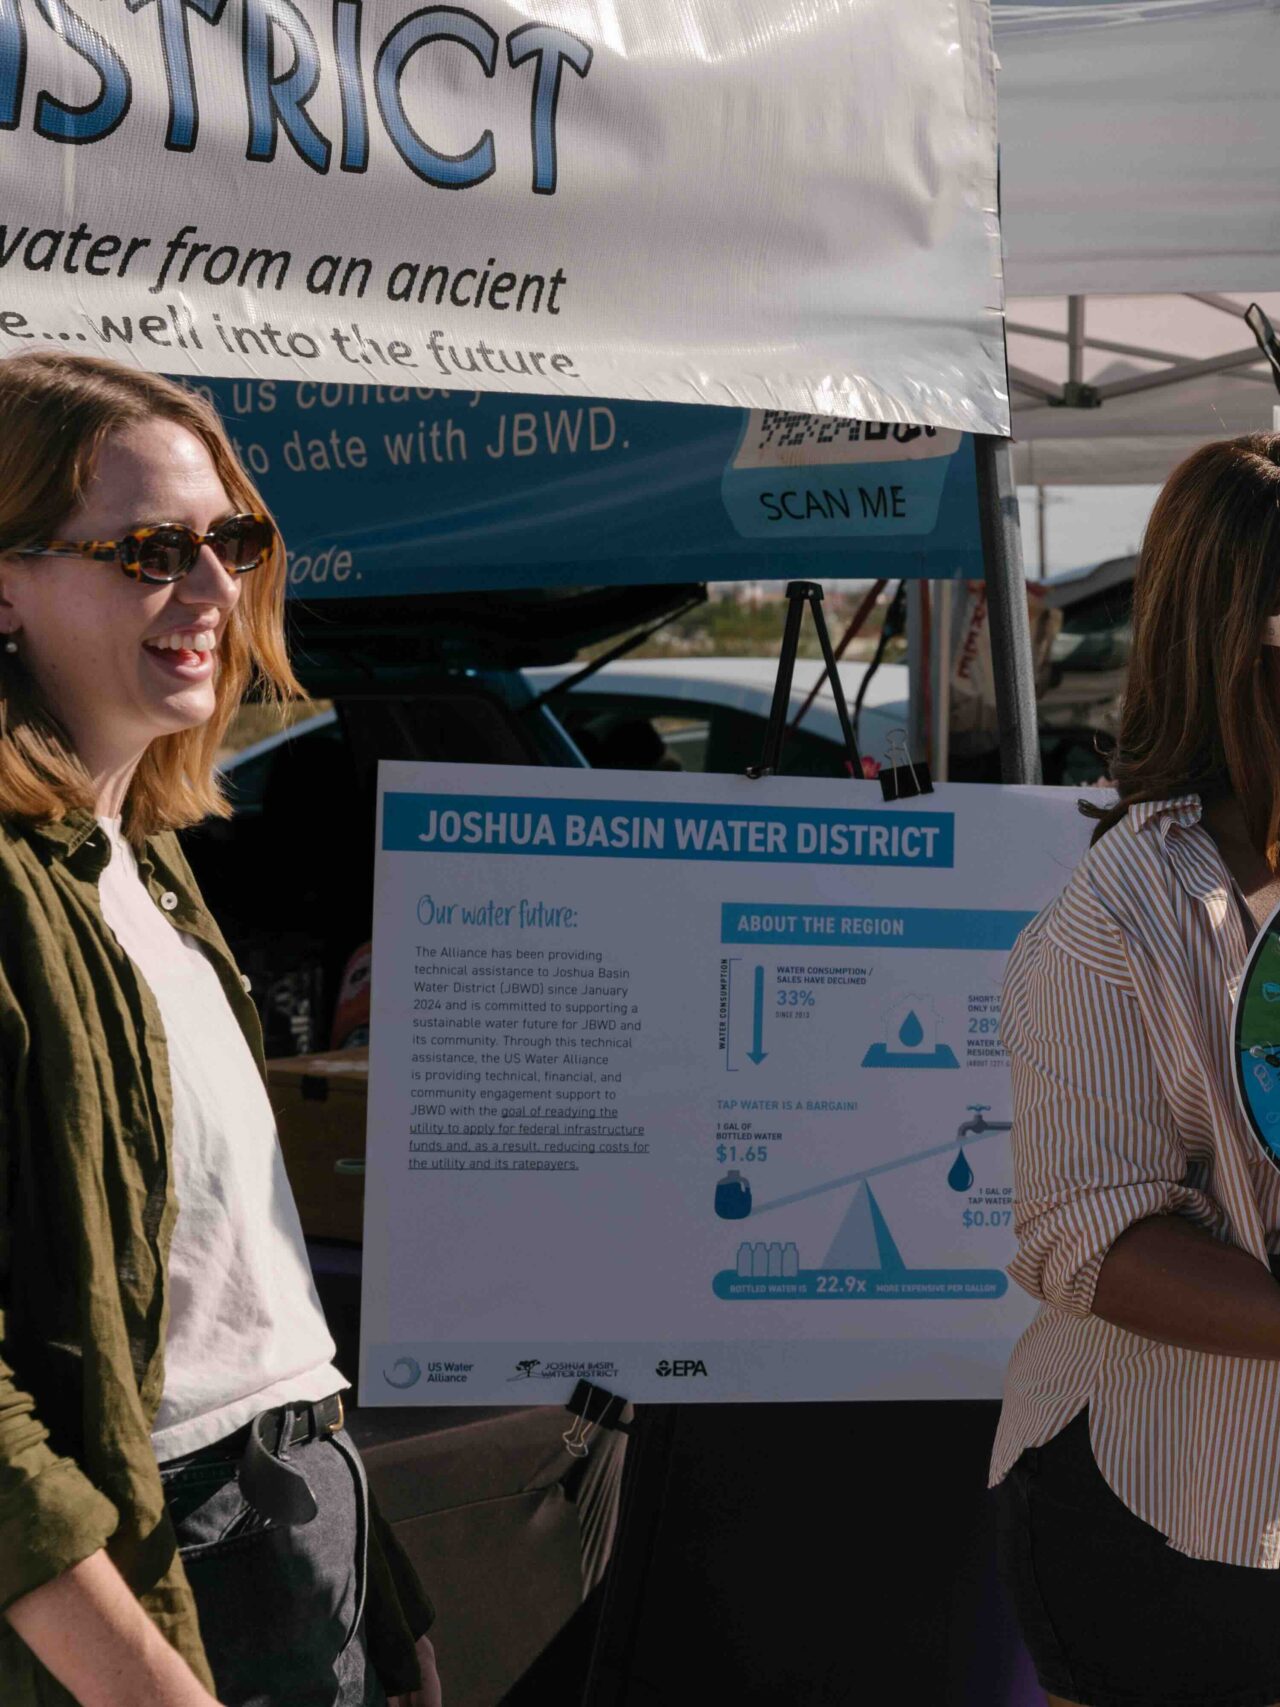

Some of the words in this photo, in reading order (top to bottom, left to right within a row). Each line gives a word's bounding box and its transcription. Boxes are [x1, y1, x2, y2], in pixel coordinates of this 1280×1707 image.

[150, 225, 291, 294] from
[306, 252, 373, 298] an
[386, 257, 567, 315] ancient
[212, 313, 321, 358] into
[330, 323, 418, 368] the
[426, 330, 580, 378] future
[233, 381, 276, 413] us
[284, 430, 368, 472] date
[384, 419, 467, 465] with
[486, 406, 629, 458] JBWD.
[760, 488, 850, 520] SCAN
[858, 486, 906, 518] ME
[418, 810, 557, 847] JOSHUA
[566, 814, 665, 850] BASIN
[674, 818, 787, 853] WATER
[797, 822, 940, 858] DISTRICT
[417, 894, 458, 925] Our
[461, 899, 515, 928] water
[518, 899, 578, 929] future:
[737, 915, 797, 932] ABOUT
[803, 916, 835, 934] THE
[841, 917, 904, 936] REGION
[416, 947, 436, 958] The
[440, 947, 487, 958] Alliance
[491, 948, 512, 959] has
[516, 949, 544, 960] been
[548, 950, 603, 962] providing
[415, 964, 468, 976] technical
[472, 966, 534, 977] assistance
[538, 967, 549, 978] to
[553, 967, 594, 978] Joshua
[598, 968, 630, 979] Basin
[808, 967, 866, 976] CONSUMPTION
[777, 976, 802, 984] SALES
[804, 976, 825, 984] HAVE
[827, 976, 866, 985] DECLINED
[414, 982, 449, 993] Water
[454, 982, 496, 994] District
[500, 982, 544, 996] (JBWD)
[548, 984, 577, 996] since
[582, 985, 628, 998] January
[720, 959, 728, 1018] CONSUMPTION
[777, 990, 815, 1006] 33%
[414, 1000, 441, 1010] 2024
[445, 1000, 466, 1010] and
[471, 1000, 481, 1010] is
[485, 1000, 546, 1012] committed
[550, 1002, 561, 1012] to
[565, 1003, 627, 1016] supporting
[631, 1004, 639, 1014] a
[413, 1017, 481, 1028] sustainable
[485, 1018, 519, 1029] water
[523, 1018, 558, 1030] future
[562, 1019, 578, 1030] for
[582, 1020, 617, 1030] JBWD
[620, 1020, 641, 1031] and
[412, 1034, 426, 1045] its
[431, 1034, 498, 1048] community.
[504, 1035, 551, 1048] Through
[555, 1036, 576, 1048] this
[581, 1036, 632, 1048] technical
[412, 1052, 477, 1065] assistance,
[482, 1052, 500, 1064] the
[504, 1054, 521, 1064] US
[525, 1054, 558, 1064] Water
[563, 1054, 608, 1065] Alliance
[411, 1070, 421, 1080] is
[425, 1070, 480, 1083] providing
[486, 1071, 540, 1083] technical,
[544, 1072, 598, 1084] financial,
[600, 1072, 621, 1082] and
[410, 1088, 476, 1100] community
[480, 1090, 551, 1101] engagement
[556, 1089, 600, 1100] support
[605, 1090, 616, 1100] to
[410, 1105, 446, 1116] JBWD
[450, 1105, 476, 1116] with
[480, 1106, 498, 1116] the
[502, 1107, 526, 1118] goal
[530, 1107, 541, 1118] of
[545, 1107, 596, 1119] readying
[600, 1108, 618, 1118] the
[718, 1100, 738, 1110] TAP
[740, 1100, 779, 1110] WATER
[782, 1100, 793, 1110] IS
[796, 1101, 803, 1110] A
[806, 1101, 858, 1112] BARGAIN!
[410, 1124, 444, 1135] utility
[448, 1124, 459, 1134] to
[462, 1124, 495, 1136] apply
[499, 1124, 516, 1134] for
[520, 1124, 560, 1135] federal
[564, 1124, 644, 1136] infrastructure
[724, 1122, 739, 1130] GAL
[741, 1122, 752, 1130] OF
[716, 1132, 752, 1140] BOTTLED
[754, 1132, 782, 1140] WATER
[410, 1141, 442, 1152] funds
[475, 1143, 488, 1152] as
[492, 1143, 498, 1152] a
[544, 1142, 595, 1154] reducing
[600, 1142, 629, 1152] costs
[633, 1142, 650, 1153] for
[716, 1144, 768, 1163] $1.65
[410, 1158, 428, 1170] the
[432, 1159, 465, 1170] utility
[470, 1159, 490, 1170] and
[494, 1159, 508, 1170] its
[513, 1160, 579, 1171] ratepayers.
[985, 1197, 1012, 1205] WATER
[963, 1208, 1012, 1228] $0.07
[730, 1284, 766, 1292] BOTTLED
[768, 1284, 796, 1292] WATER
[816, 1276, 866, 1293] 22.9x
[876, 1284, 899, 1292] MORE
[902, 1284, 946, 1292] EXPENSIVE
[947, 1284, 962, 1292] PER
[428, 1362, 442, 1372] US
[444, 1362, 474, 1372] Water
[545, 1362, 585, 1370] JOSHUA
[672, 1360, 708, 1376] EPA
[427, 1373, 468, 1382] Alliance
[541, 1370, 575, 1378] WATER
[576, 1369, 619, 1378] DISTRICT
